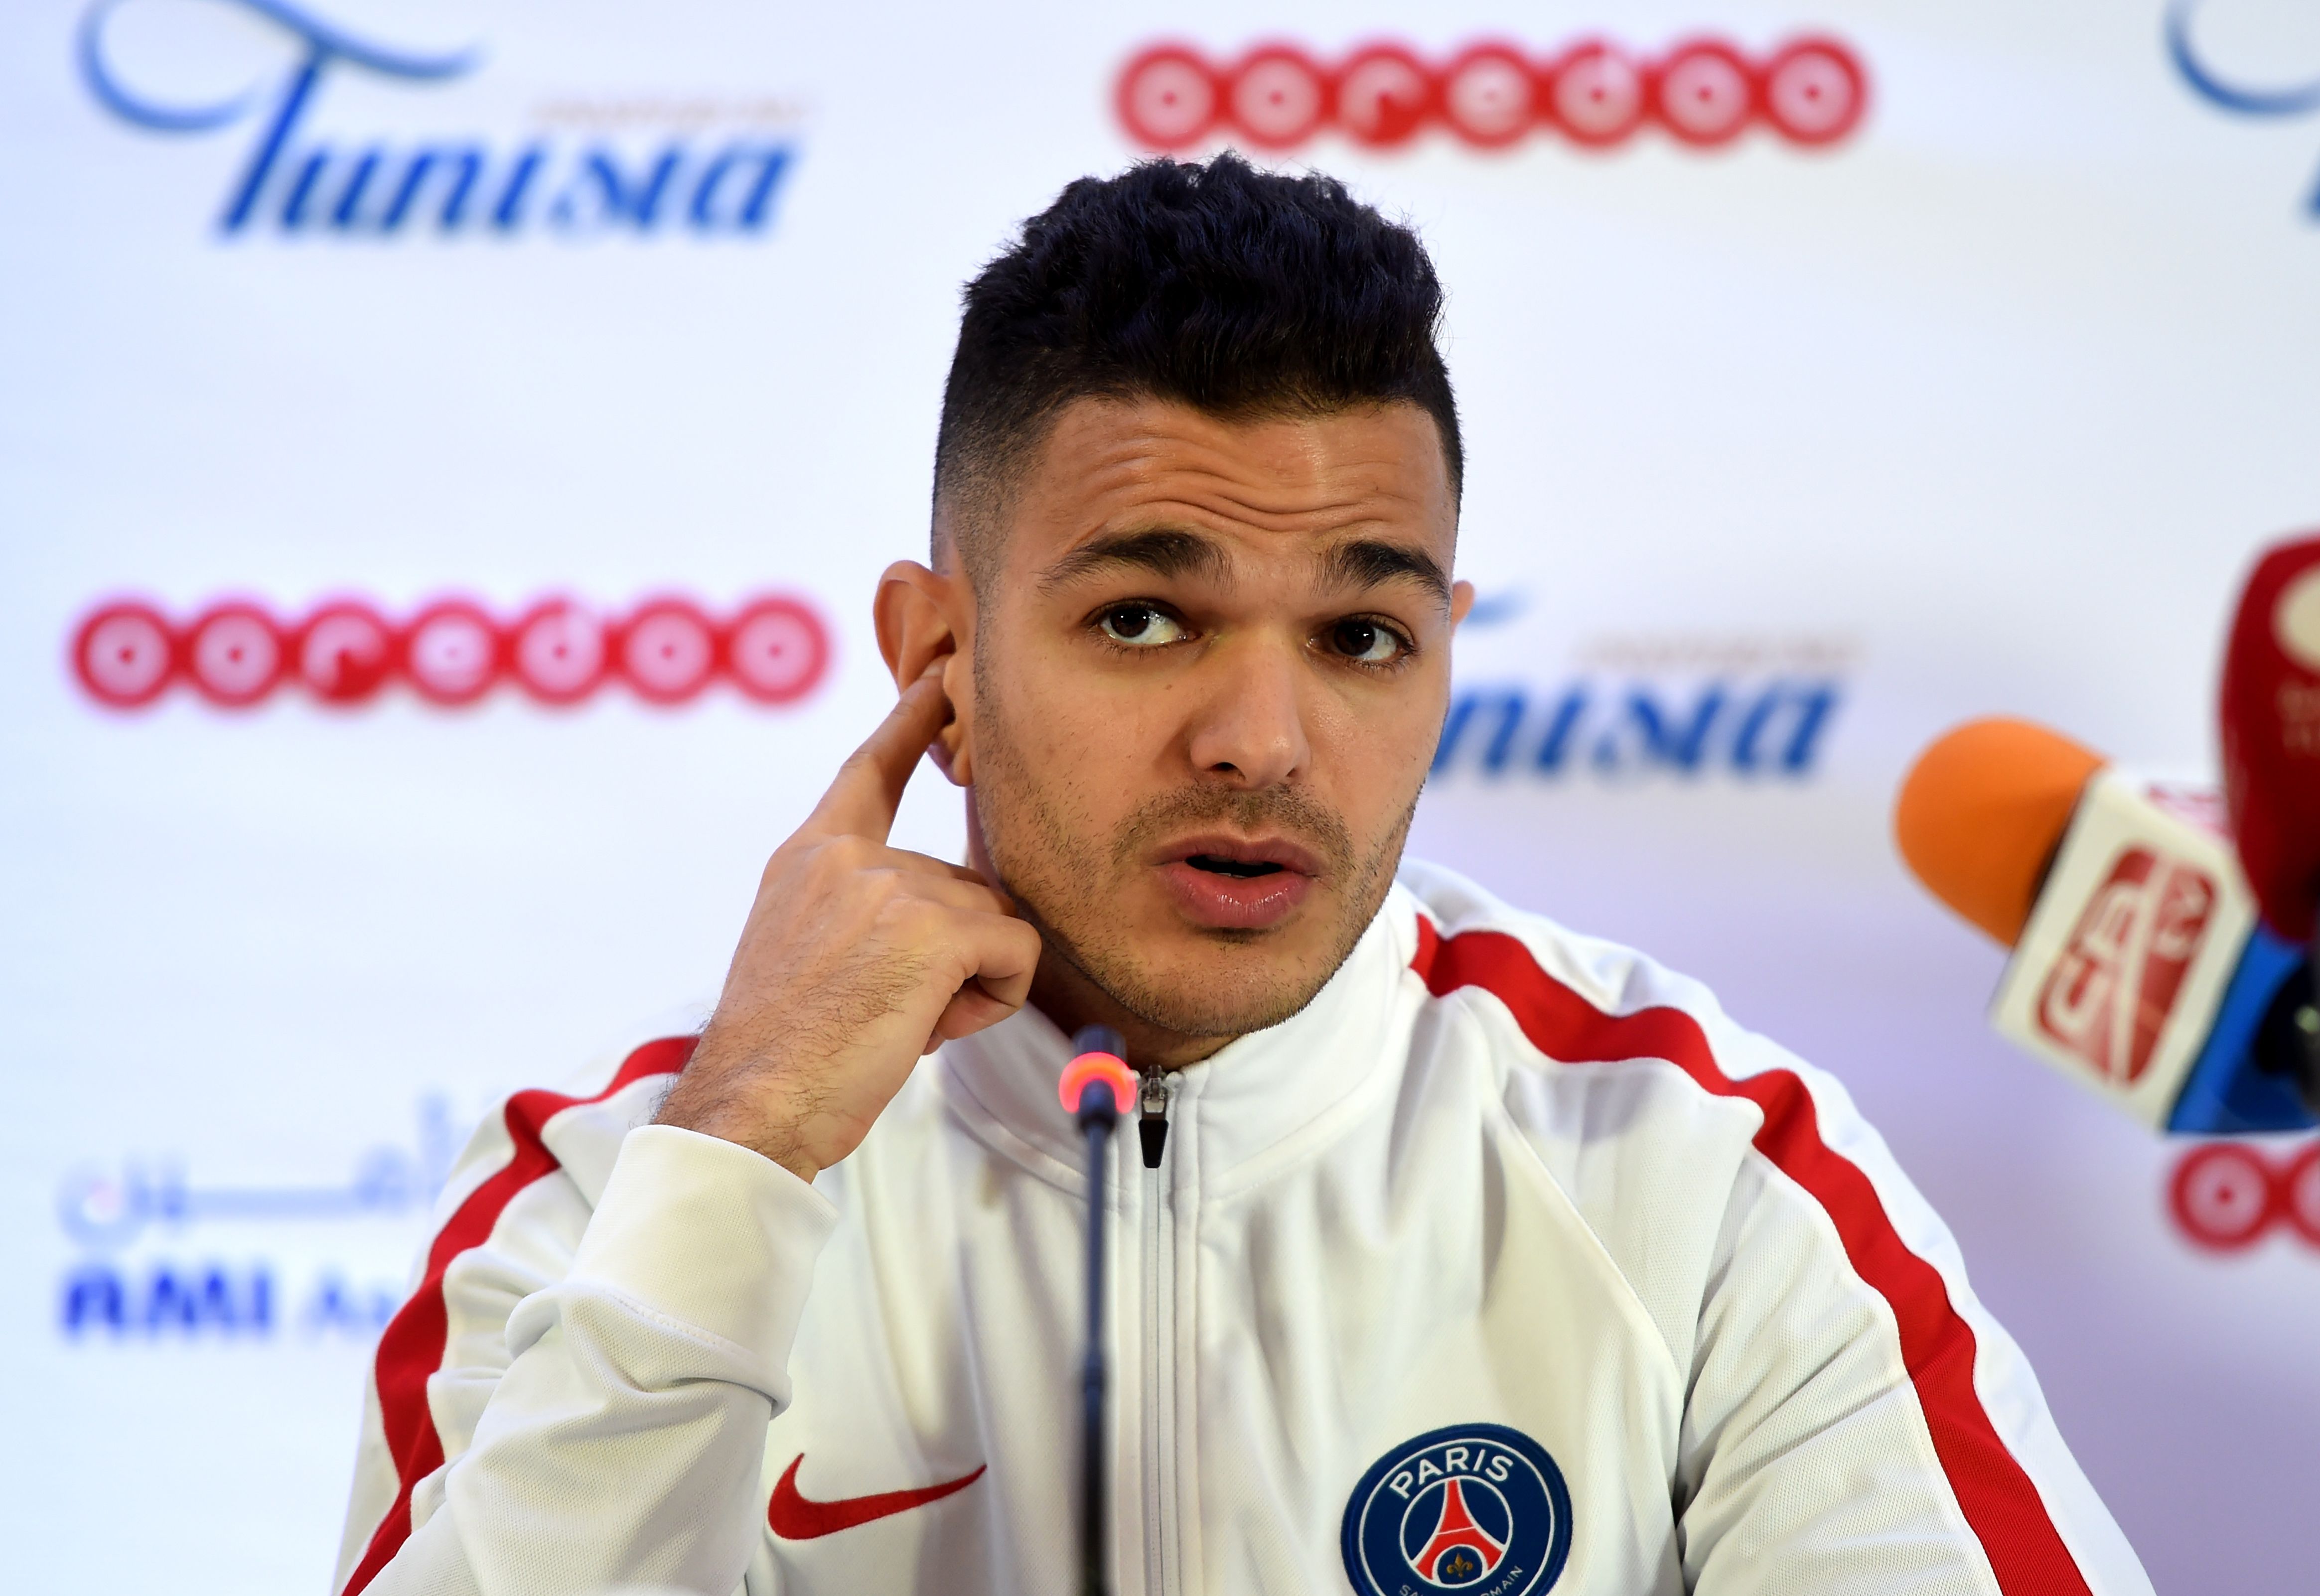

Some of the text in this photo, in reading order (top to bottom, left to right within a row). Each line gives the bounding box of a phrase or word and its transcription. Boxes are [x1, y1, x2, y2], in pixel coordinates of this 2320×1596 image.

[1116, 37, 1869, 148] ooredoo
[75, 600, 827, 705] ooredoo
[1389, 1447, 1514, 1499] PARIS
